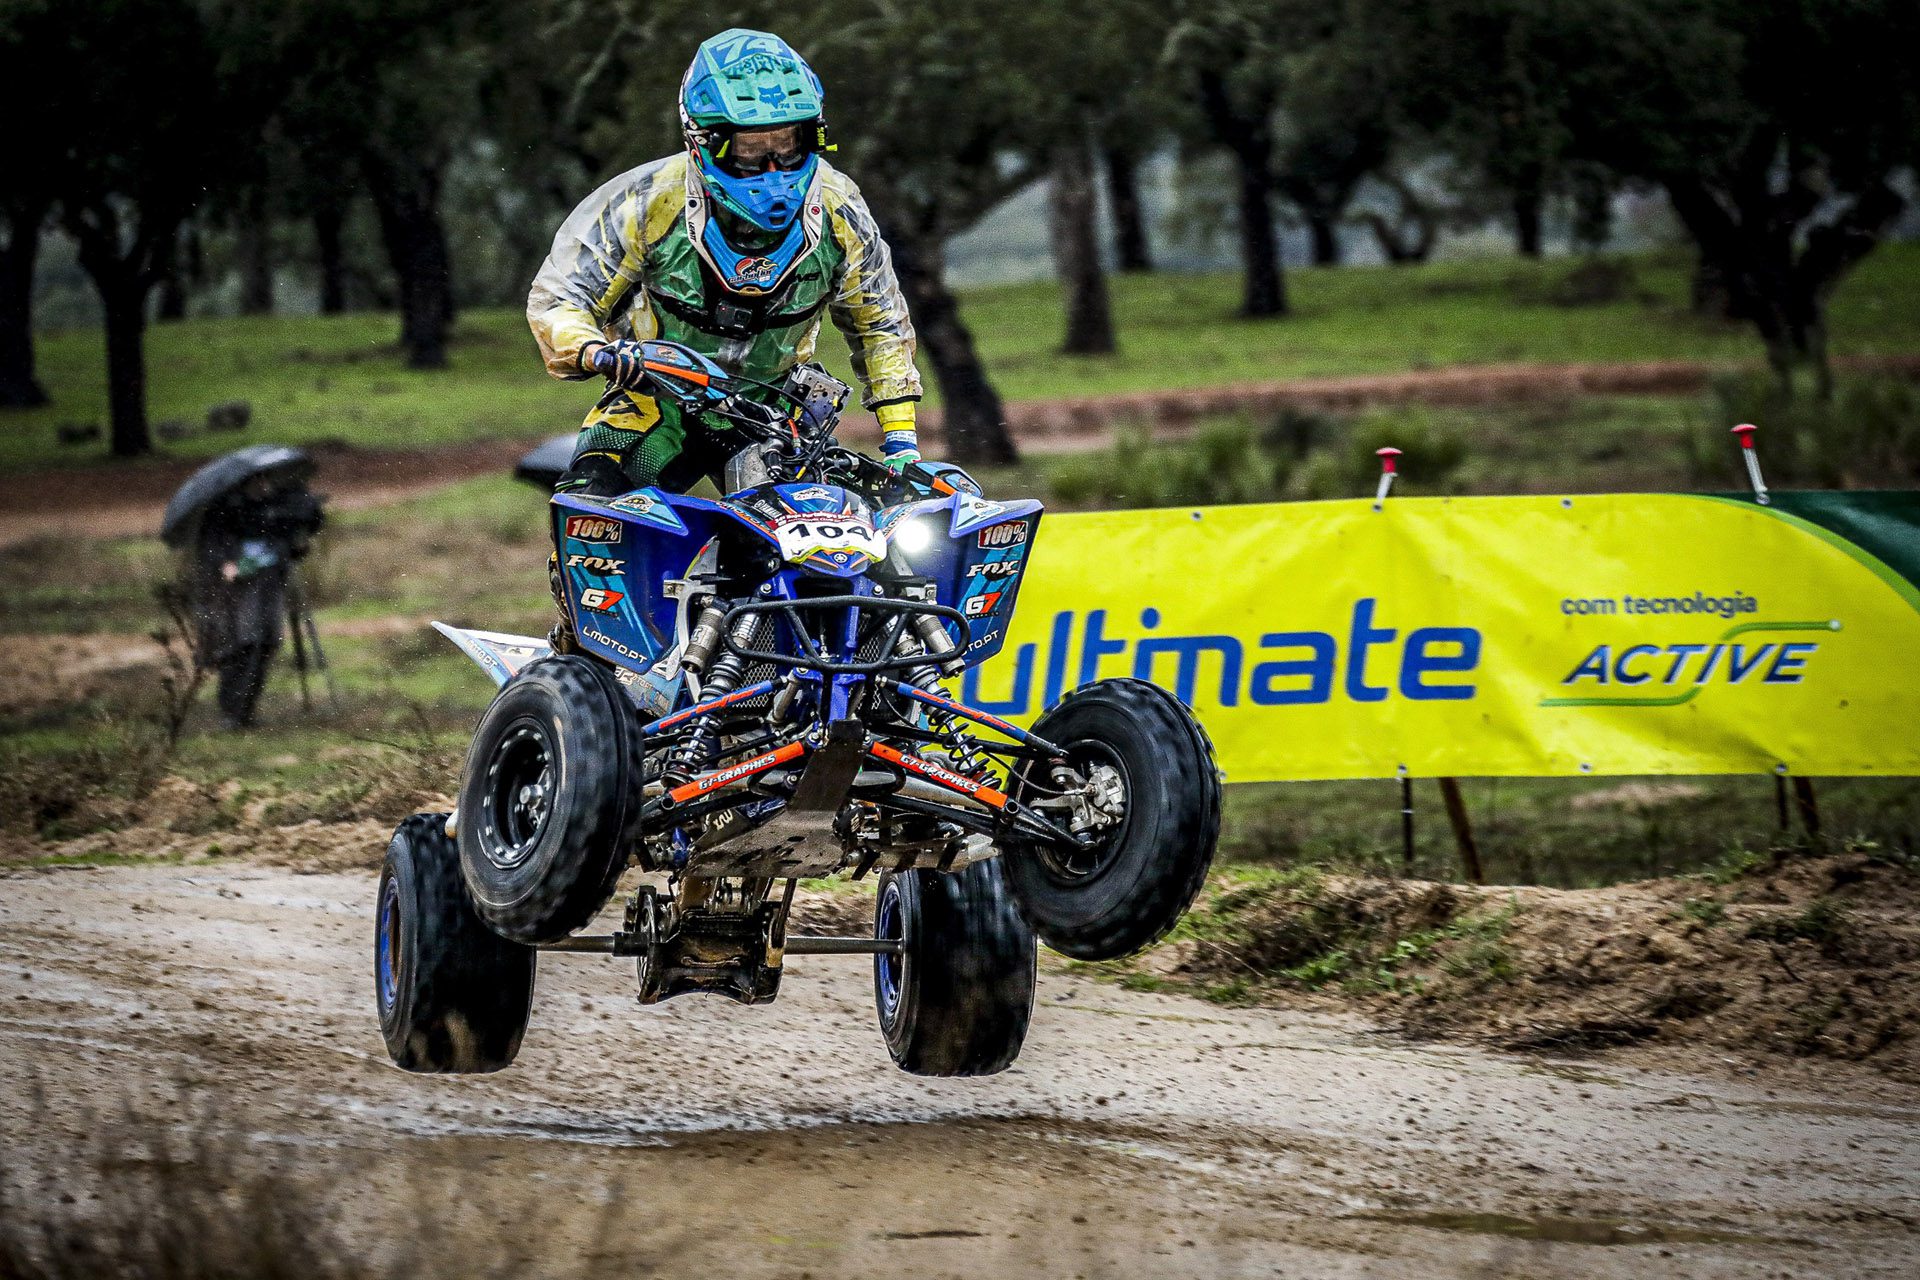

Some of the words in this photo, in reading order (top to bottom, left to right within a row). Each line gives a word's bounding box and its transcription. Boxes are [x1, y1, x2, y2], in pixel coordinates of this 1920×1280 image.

[716, 35, 783, 64] 74
[571, 519, 619, 541] 100%
[788, 523, 872, 542] 104
[984, 524, 1025, 546] 100%
[566, 555, 626, 575] FOX
[966, 560, 1019, 577] FOX
[580, 588, 624, 611] G7
[966, 591, 1002, 615] G7
[1560, 594, 1617, 616] com
[1623, 590, 1759, 619] tecnologia
[582, 626, 648, 664] LMOTO.PT
[961, 597, 1483, 716] ultimate
[1562, 641, 1820, 686] ACTIVE
[698, 754, 776, 790] G7-GRAPHICS
